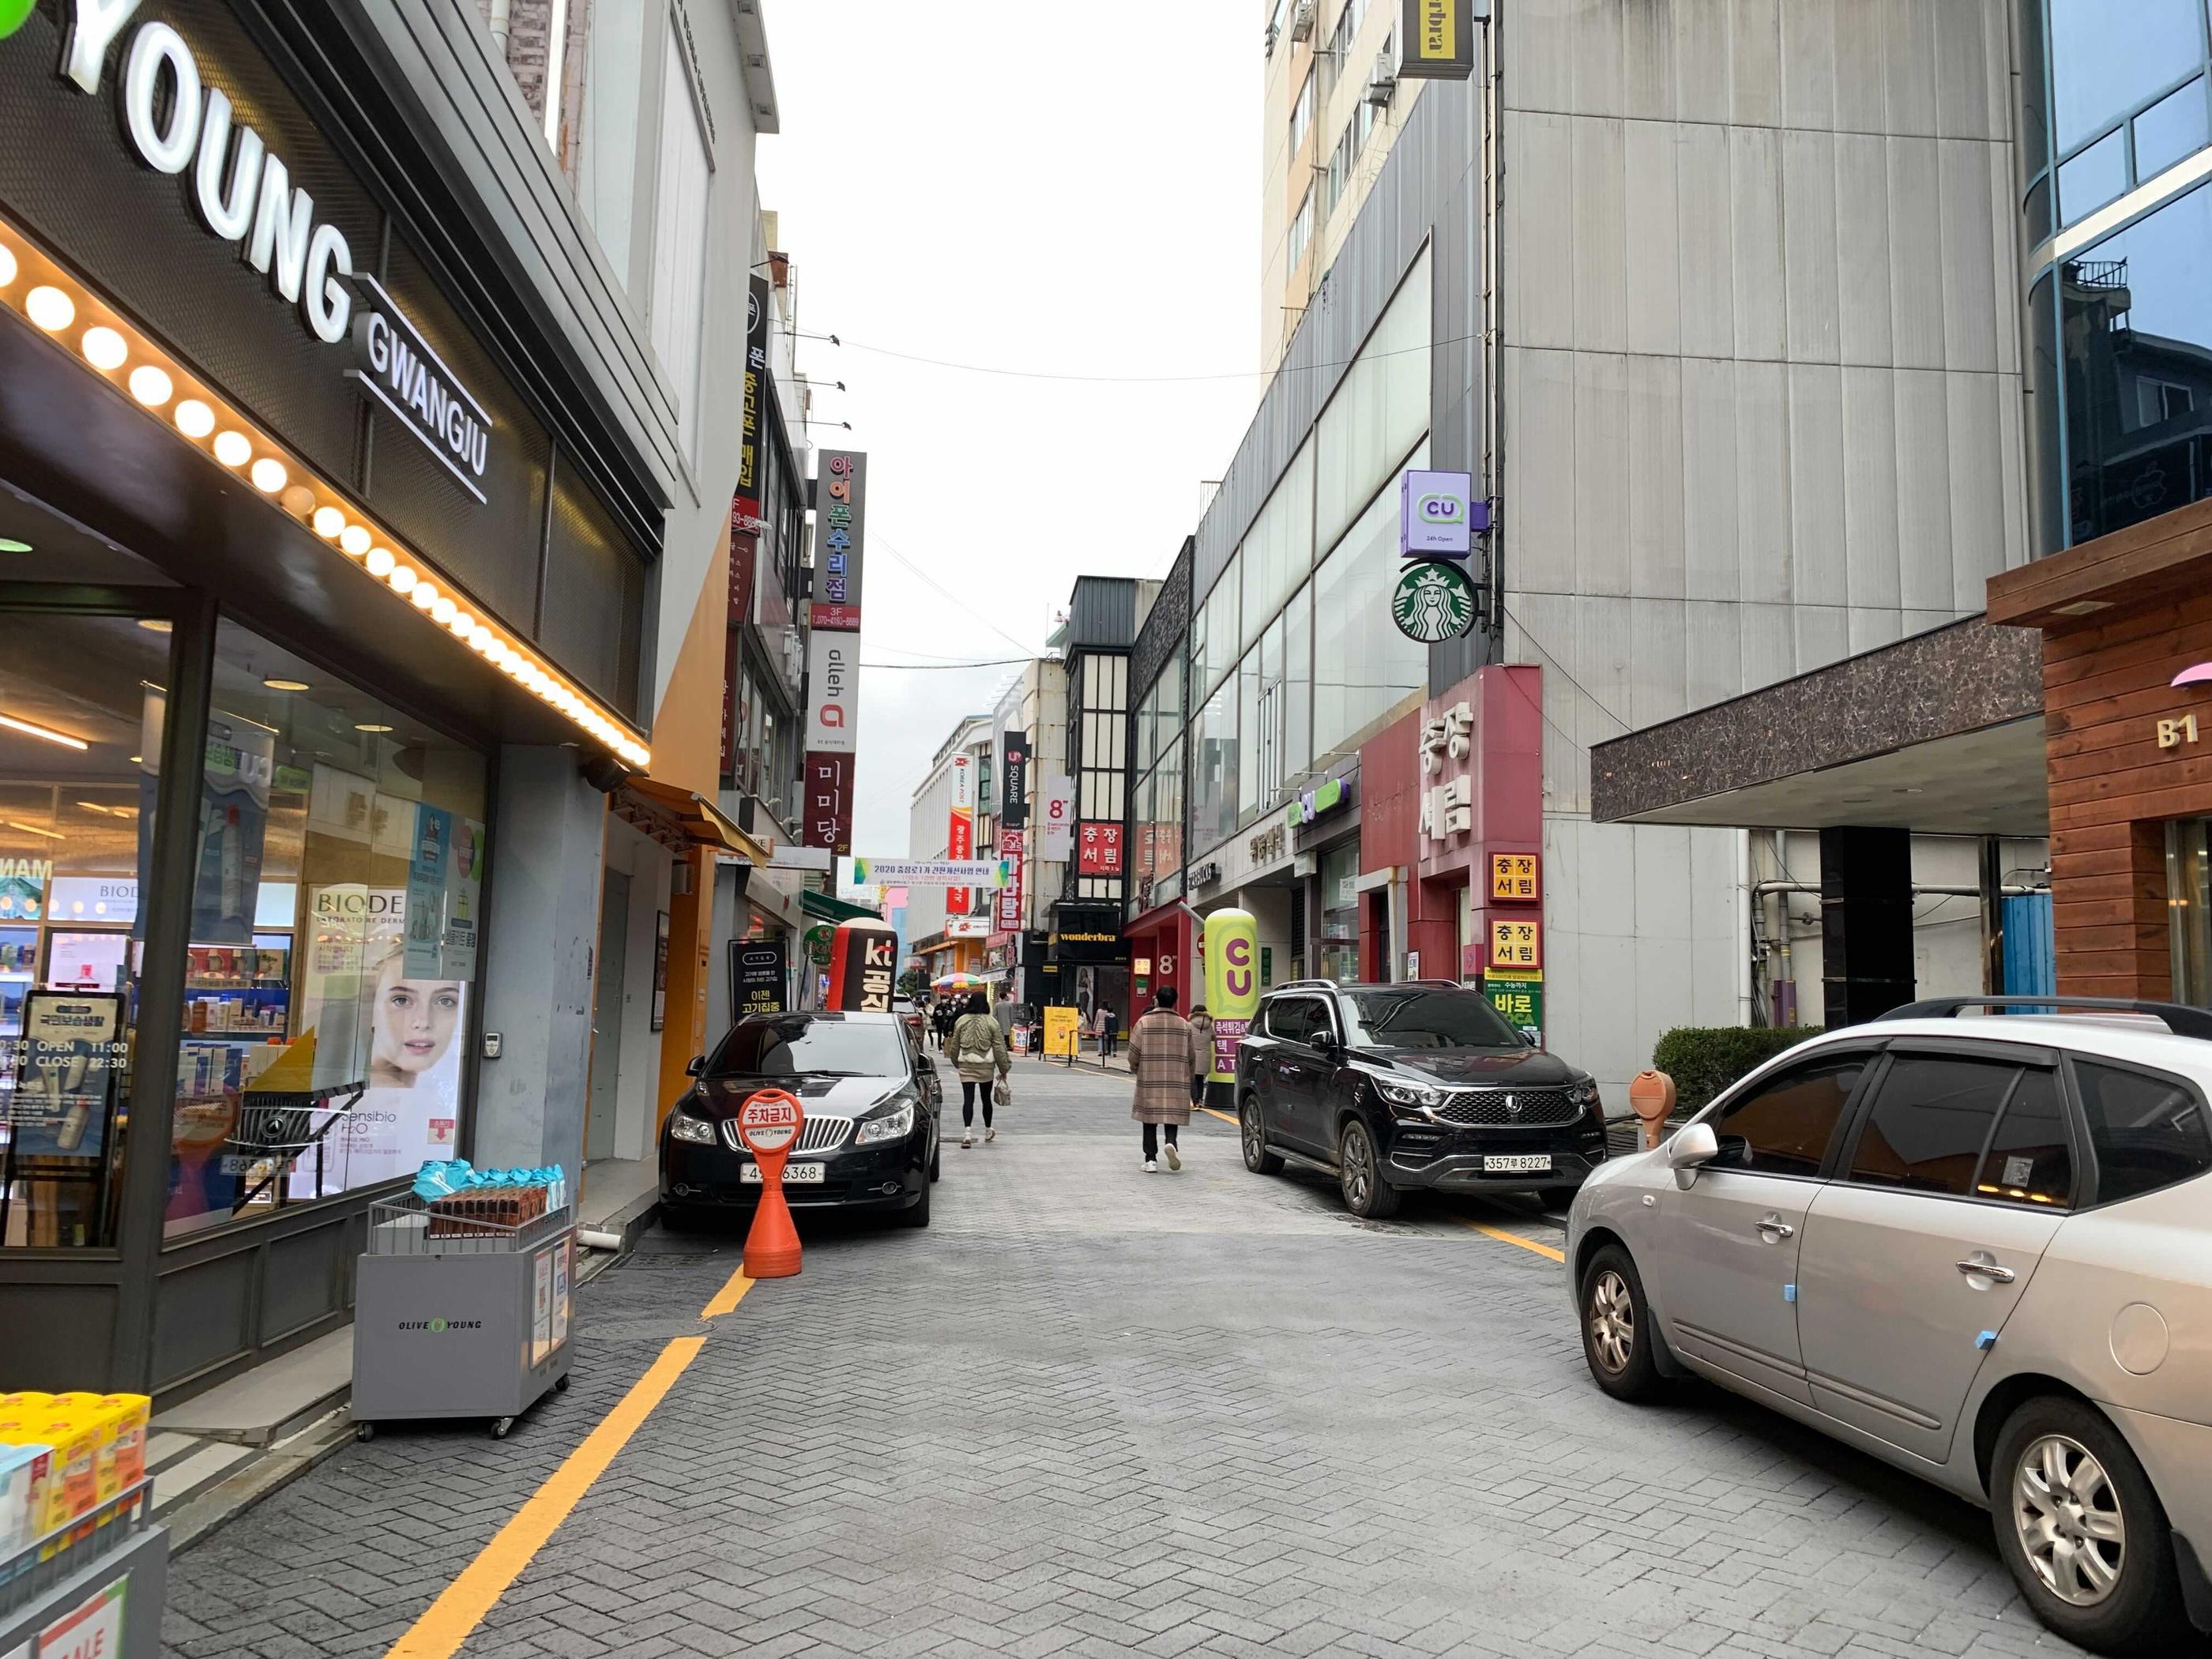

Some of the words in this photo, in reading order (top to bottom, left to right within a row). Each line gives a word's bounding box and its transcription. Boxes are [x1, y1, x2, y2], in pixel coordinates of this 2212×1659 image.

[1428, 0, 1446, 51] rbra
[63, 0, 356, 344] YOUNG
[367, 311, 487, 476] GWANGJU
[1427, 501, 1454, 515] CU
[830, 607, 843, 616] 3F
[1419, 702, 1474, 775] 충장
[2157, 713, 2199, 749] B1
[1010, 765, 1019, 804] SQUARE
[817, 760, 841, 843] 미미당
[1419, 774, 1472, 840] 서림
[1083, 826, 1118, 844] 충장
[837, 844, 848, 852] 2F
[1083, 847, 1117, 864] 서림
[874, 865, 895, 874] 2020
[1496, 858, 1533, 875] 충장
[1496, 878, 1533, 894] 서림
[318, 893, 404, 914] BIODE
[1060, 933, 1117, 942] wonderbra
[1496, 924, 1533, 942] 충장
[864, 938, 893, 966] kt
[1496, 947, 1533, 961] 서림
[1225, 938, 1251, 997] CU
[1495, 994, 1533, 1014] 바로
[36, 1041, 75, 1052] OPEN
[747, 1107, 792, 1123] 주차금지
[1520, 1157, 1548, 1169] 8227
[782, 1166, 816, 1179] 6368
[398, 1321, 429, 1330] OLIVE
[446, 1320, 482, 1330] YOUNG
[62, 1627, 104, 1659] ALE
